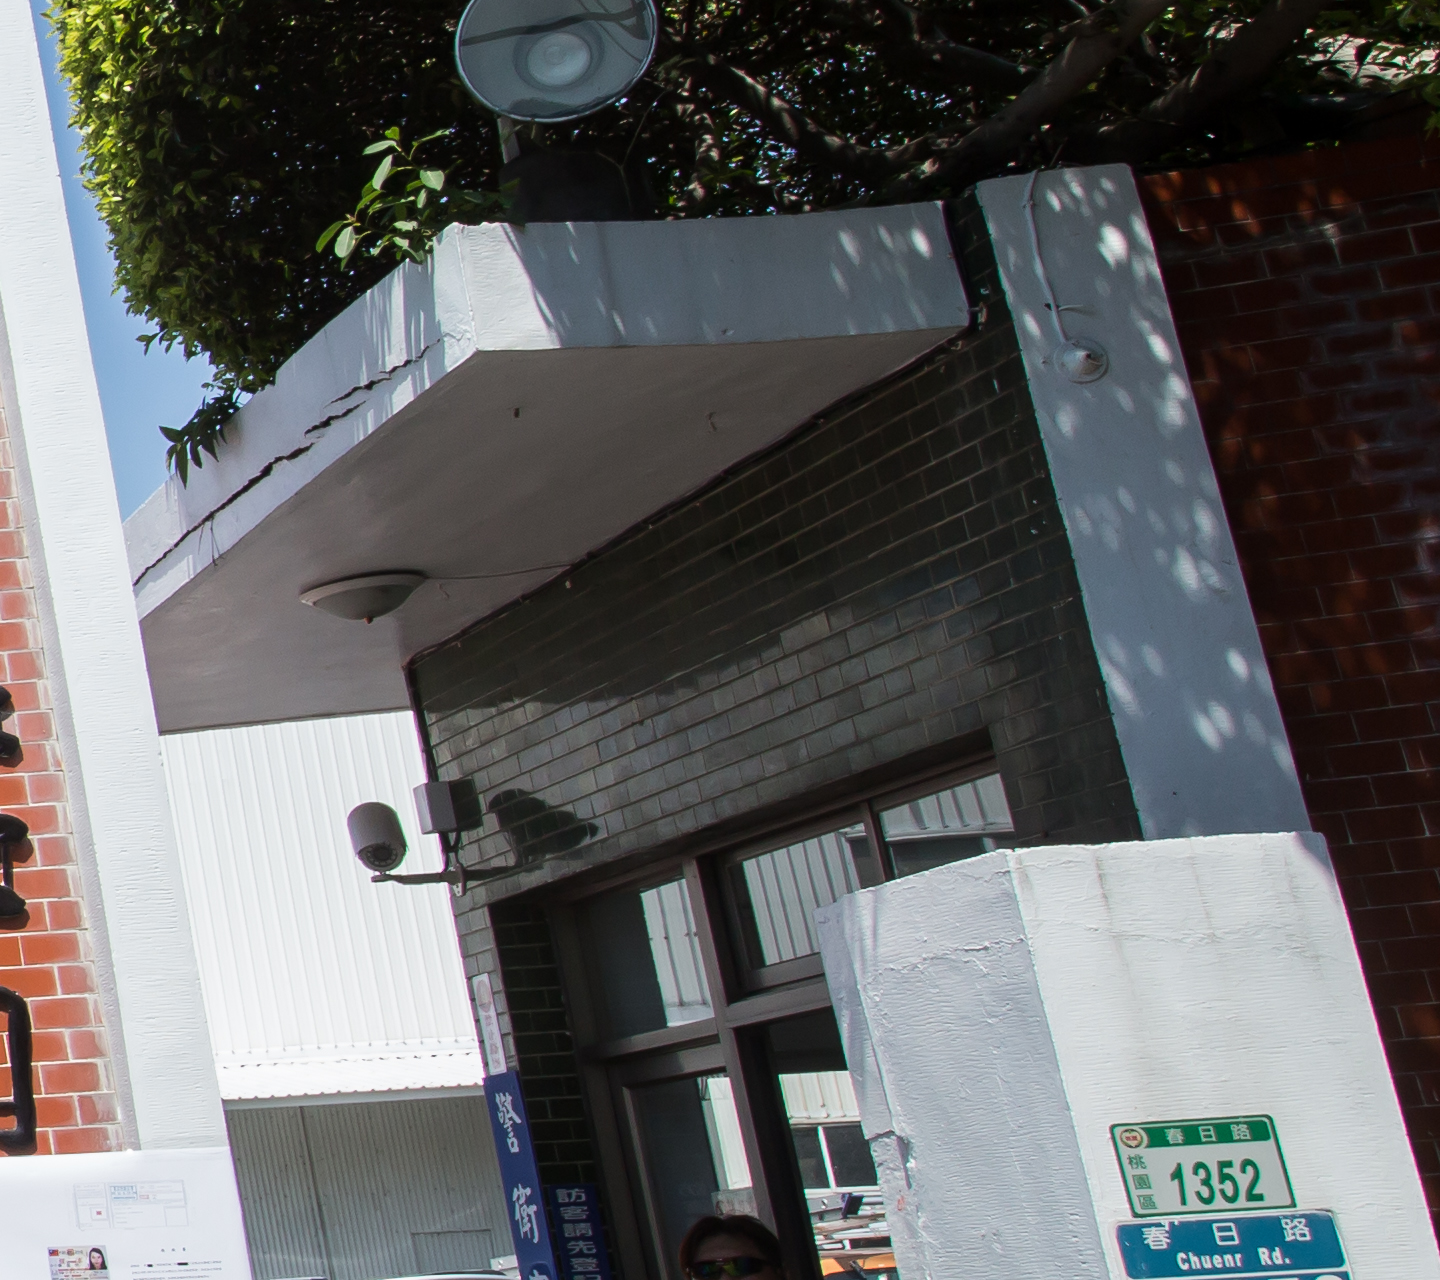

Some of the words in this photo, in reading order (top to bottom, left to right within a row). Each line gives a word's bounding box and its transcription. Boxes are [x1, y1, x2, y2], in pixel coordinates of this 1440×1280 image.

[1164, 1123, 1252, 1145] 春日路
[1127, 1154, 1158, 1210] 桃園區
[1169, 1158, 1265, 1206] 1352
[1141, 1217, 1312, 1250] 春日路
[1176, 1251, 1243, 1270] Chuenr
[1257, 1246, 1291, 1265] Rd.
